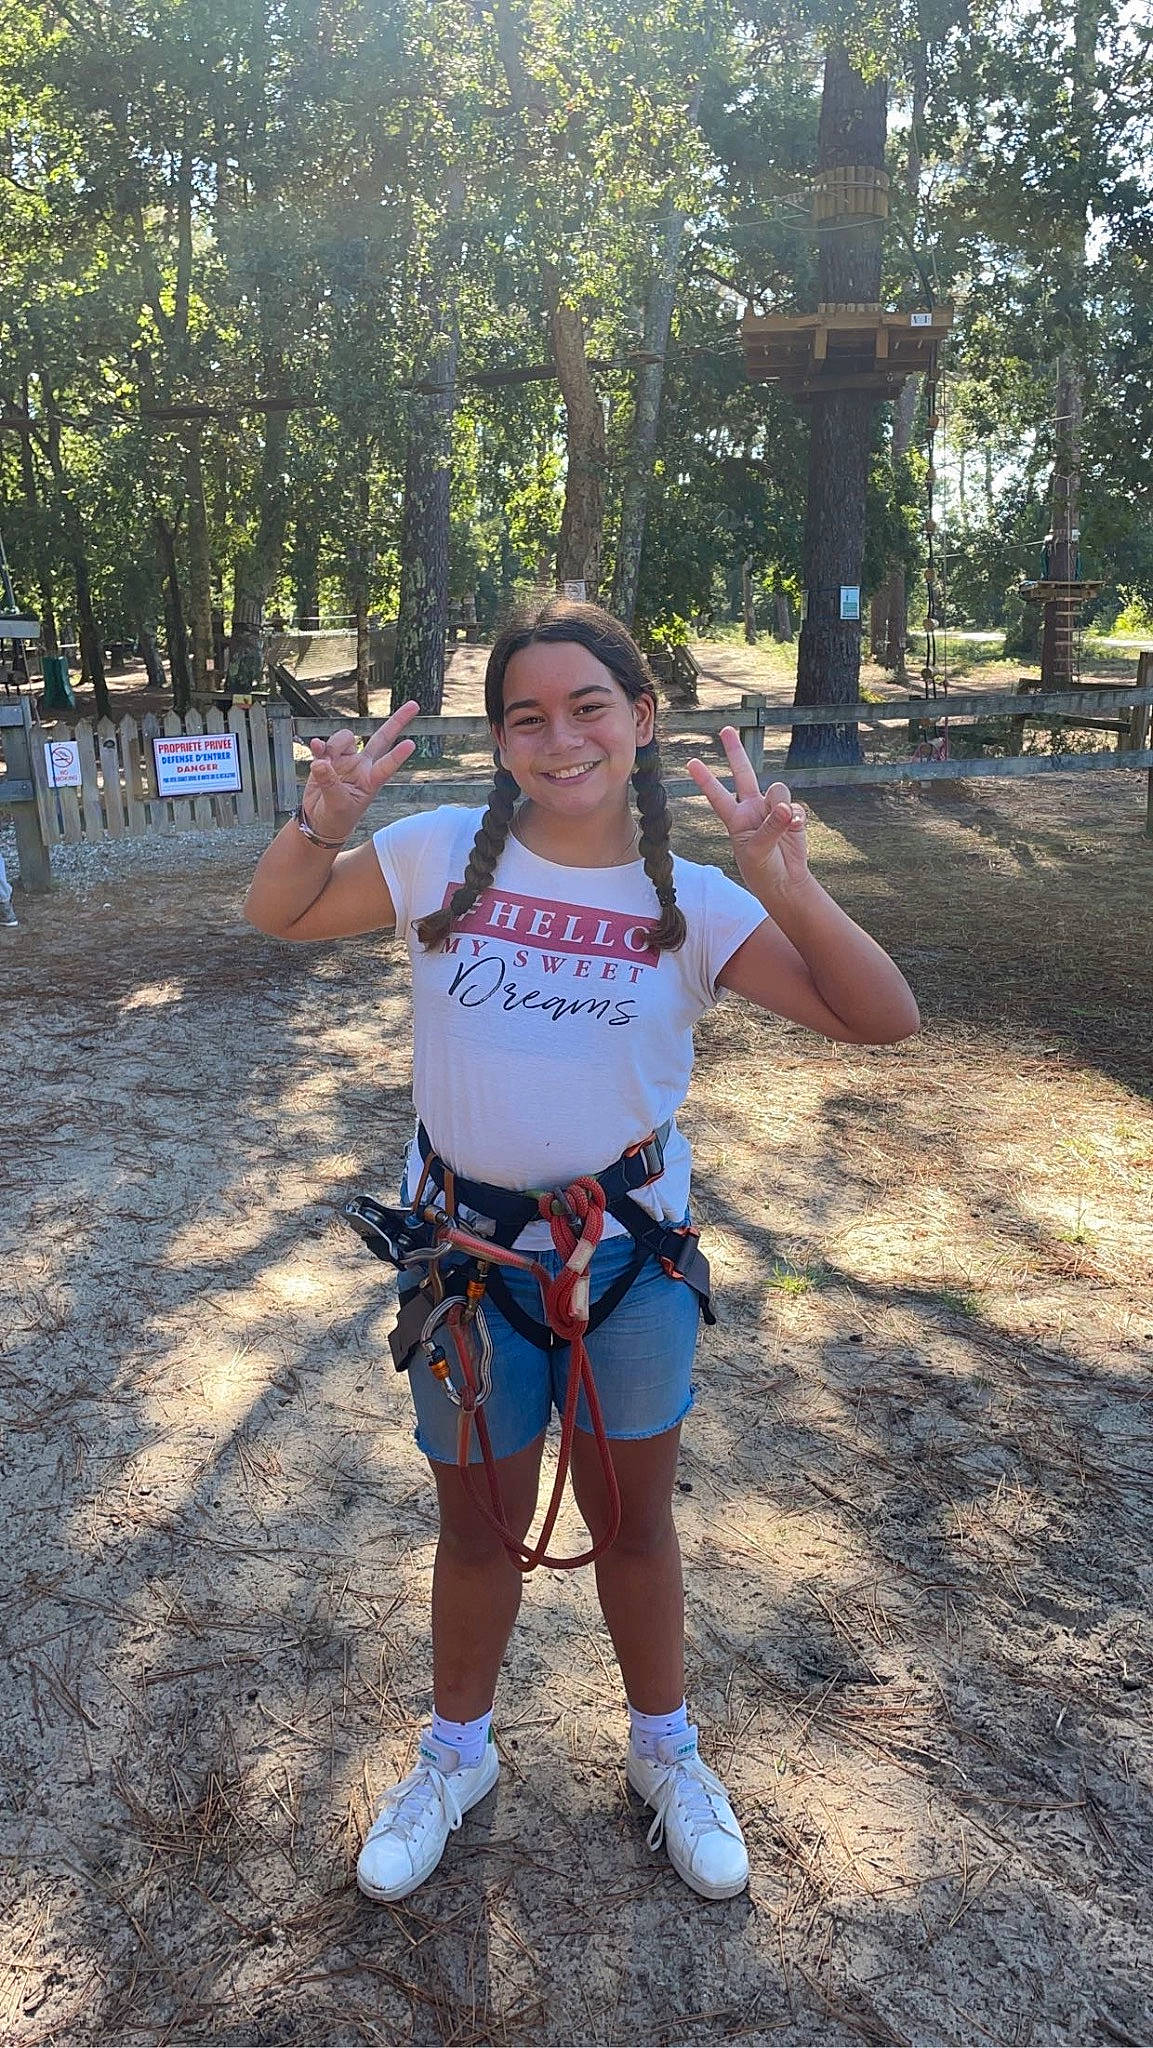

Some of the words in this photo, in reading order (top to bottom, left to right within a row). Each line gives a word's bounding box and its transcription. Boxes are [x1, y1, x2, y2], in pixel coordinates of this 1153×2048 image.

[176, 763, 218, 773] DANGER
[195, 751, 231, 762] D'ENTRER
[440, 937, 489, 957] MY
[513, 950, 643, 984] SWEET
[448, 956, 638, 1026] Dreams
